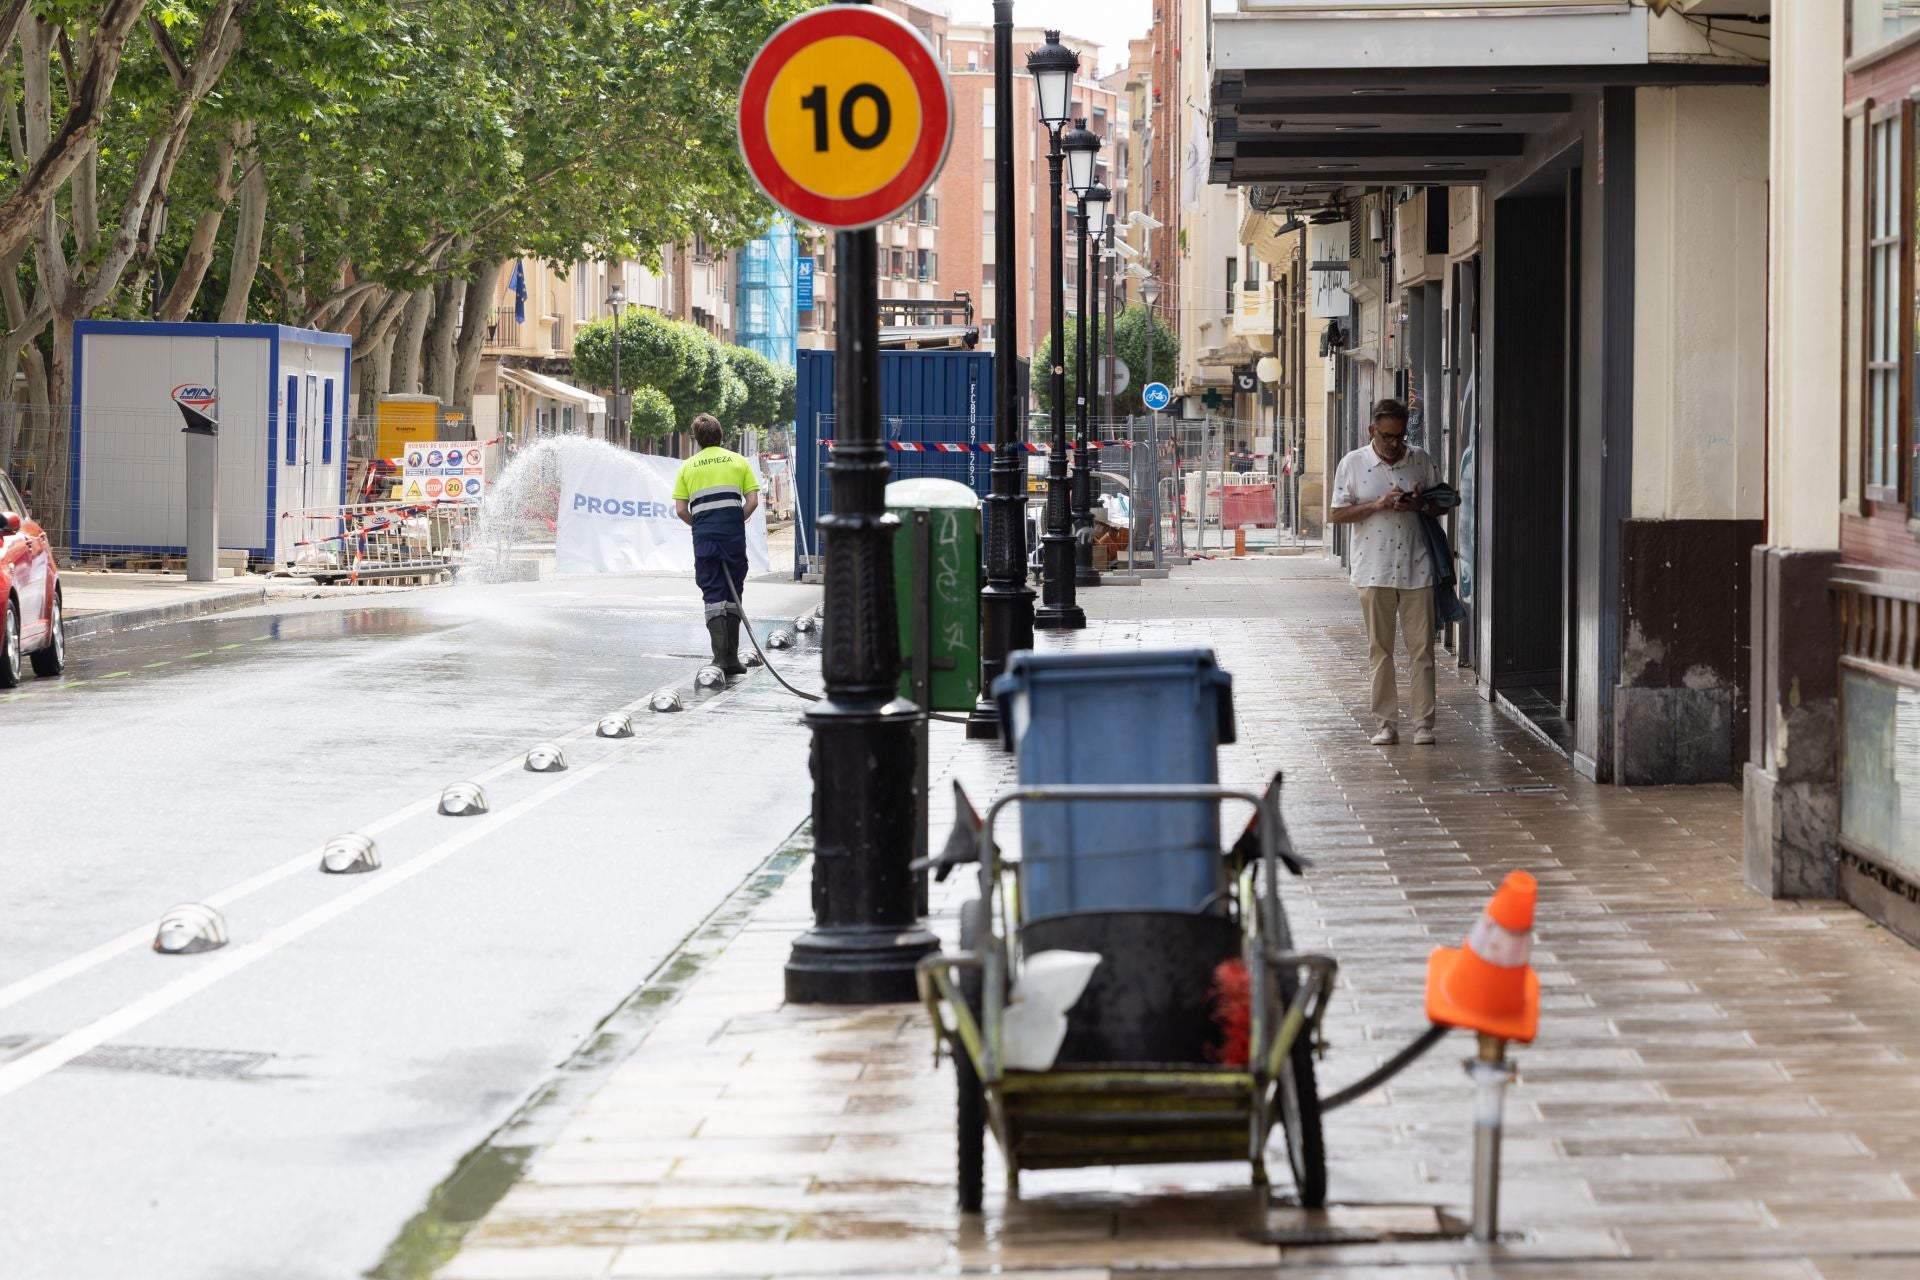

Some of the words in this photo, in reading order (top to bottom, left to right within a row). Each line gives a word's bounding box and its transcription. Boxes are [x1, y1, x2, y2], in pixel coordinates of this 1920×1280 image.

[801, 83, 891, 152] 10
[693, 455, 733, 468] LIMPIEZA
[427, 484, 441, 492] STOP
[448, 483, 460, 492] 20
